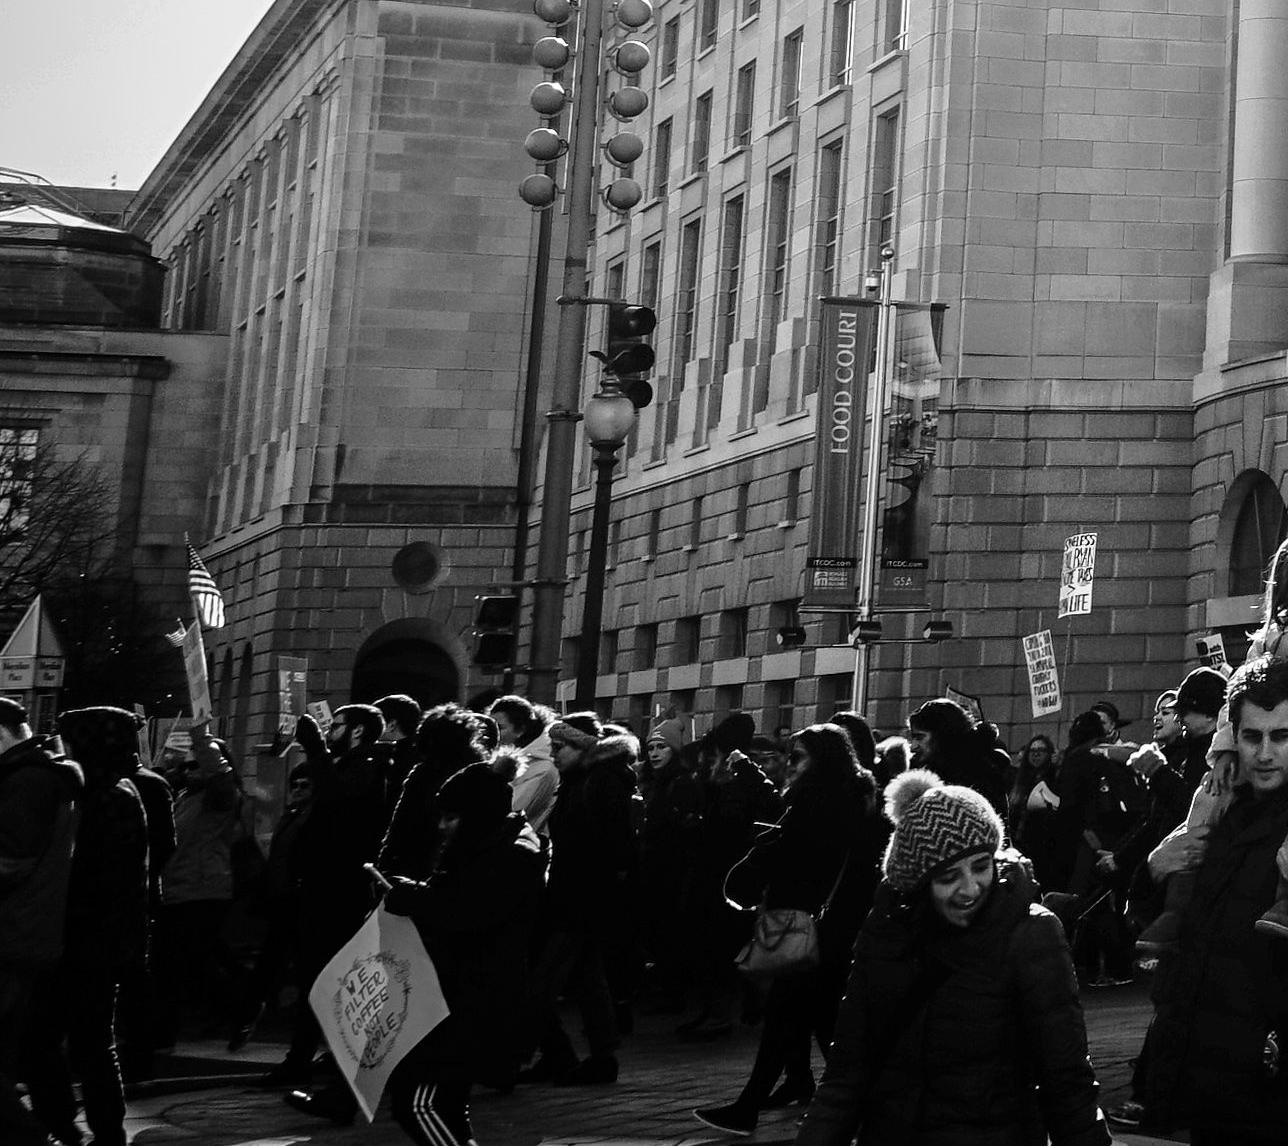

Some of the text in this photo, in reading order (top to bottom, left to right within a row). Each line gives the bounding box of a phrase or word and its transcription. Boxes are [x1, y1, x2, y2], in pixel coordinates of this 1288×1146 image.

[830, 309, 857, 454] FOOD COURT
[893, 576, 913, 586] GSA
[345, 971, 385, 1021] FILTER
[346, 967, 368, 995] WE
[352, 986, 389, 1035] COFFEE
[364, 1009, 382, 1035] NOT
[365, 1012, 397, 1062] PEOPLE
